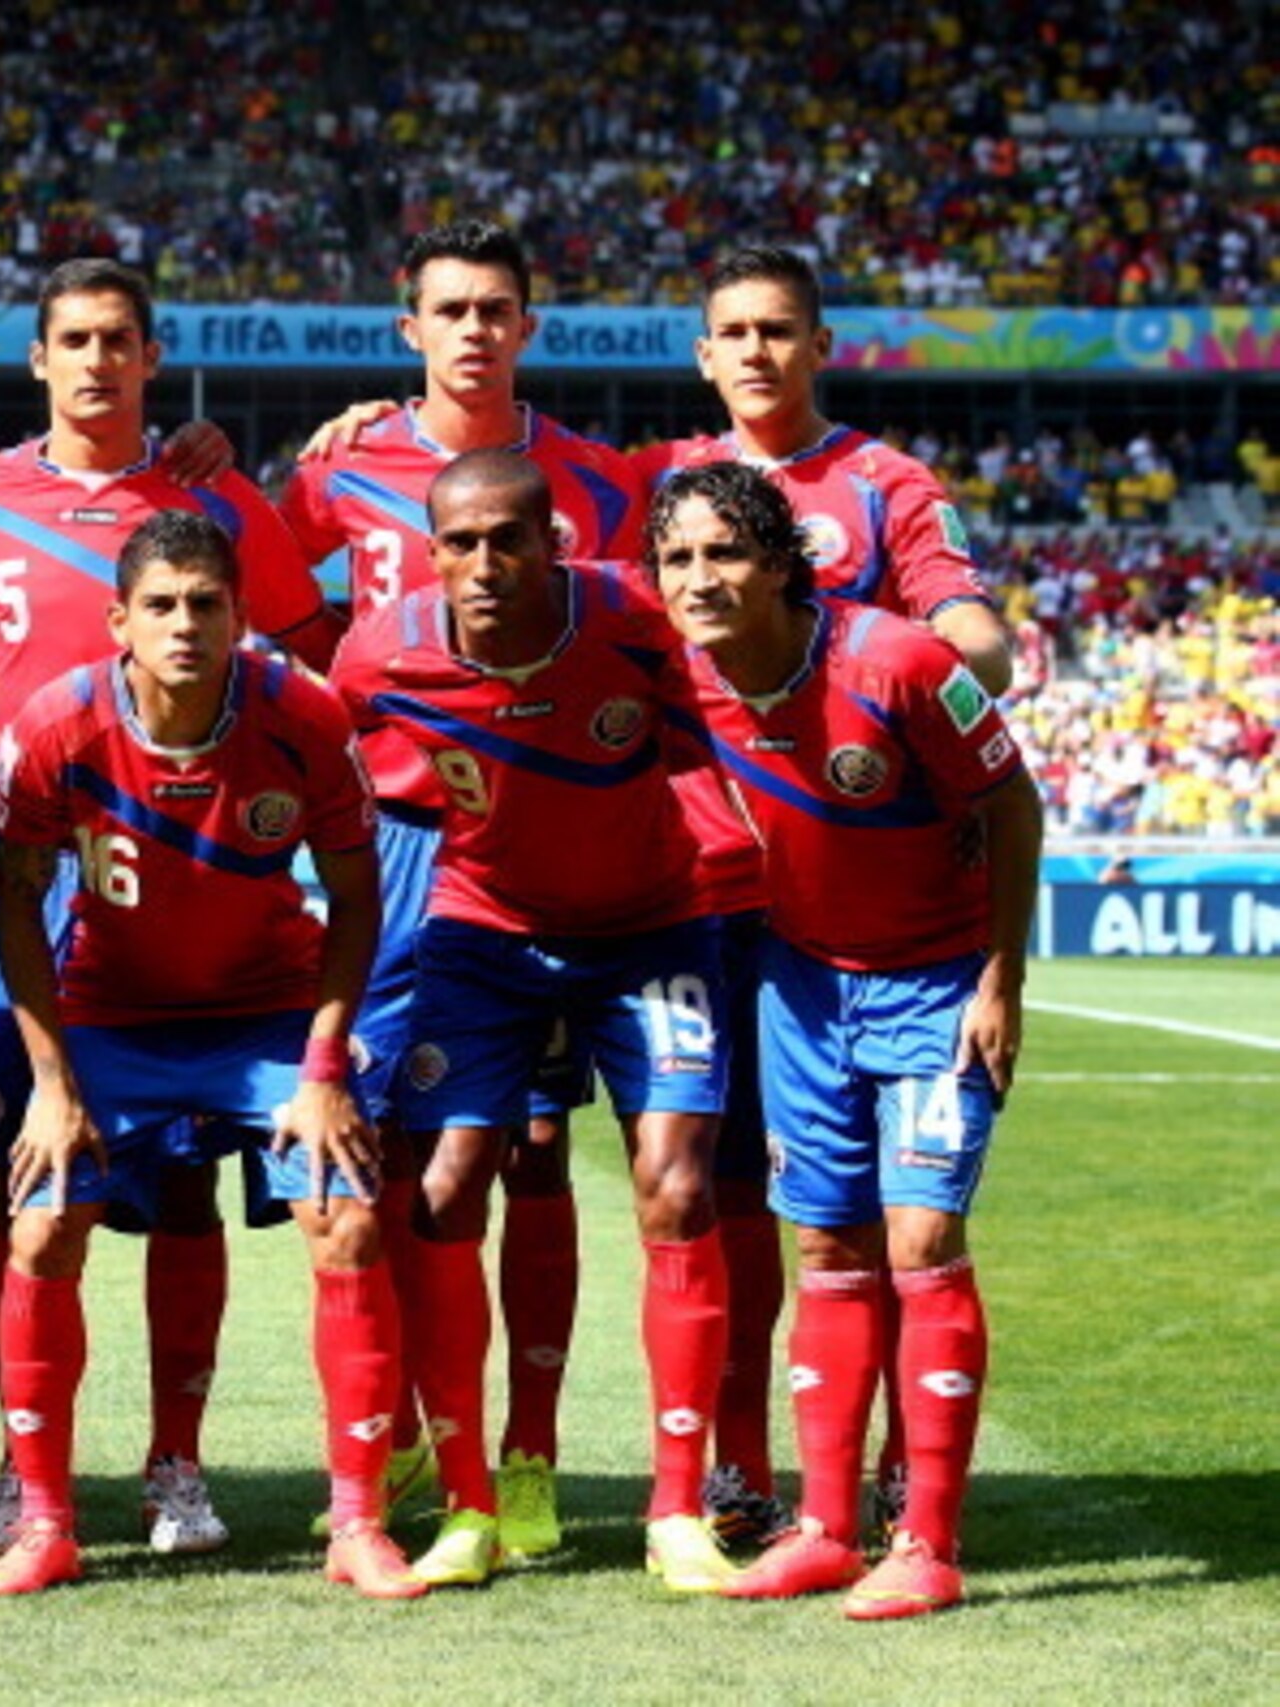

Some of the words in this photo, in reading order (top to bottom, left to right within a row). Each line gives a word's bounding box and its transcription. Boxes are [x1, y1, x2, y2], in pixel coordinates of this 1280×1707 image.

[200, 315, 289, 354] FIFA
[543, 316, 670, 356] Brazil
[365, 529, 402, 608] 3
[74, 825, 140, 908] 16
[1089, 890, 1216, 955] ALL
[641, 973, 717, 1055] 19
[898, 1072, 965, 1152] 14
